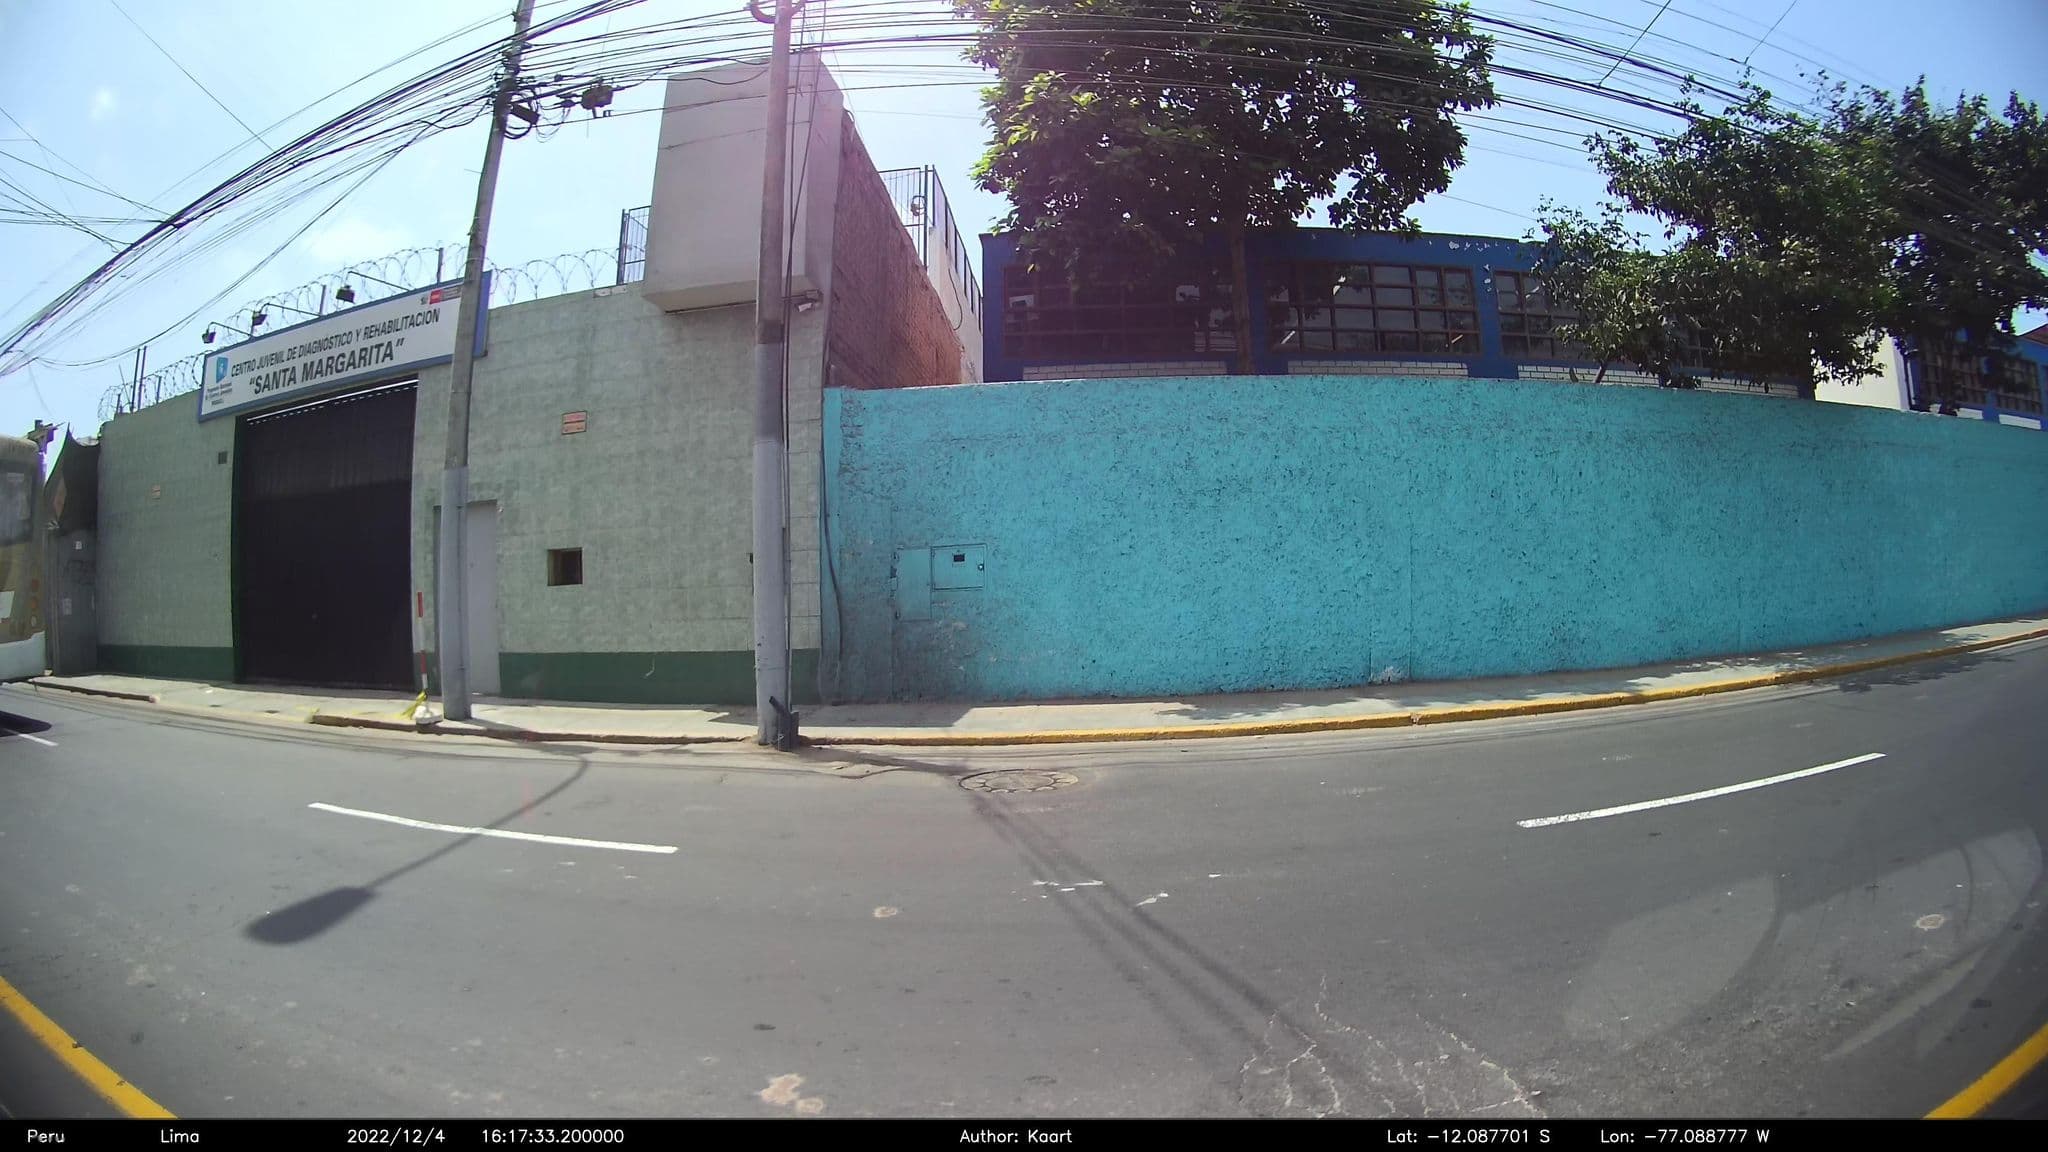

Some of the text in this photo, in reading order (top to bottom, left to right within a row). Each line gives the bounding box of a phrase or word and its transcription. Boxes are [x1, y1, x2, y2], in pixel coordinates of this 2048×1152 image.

[231, 358, 257, 377] CENTRO
[256, 350, 285, 370] JUVENIL
[286, 346, 297, 361] DE
[355, 328, 362, 343] Y
